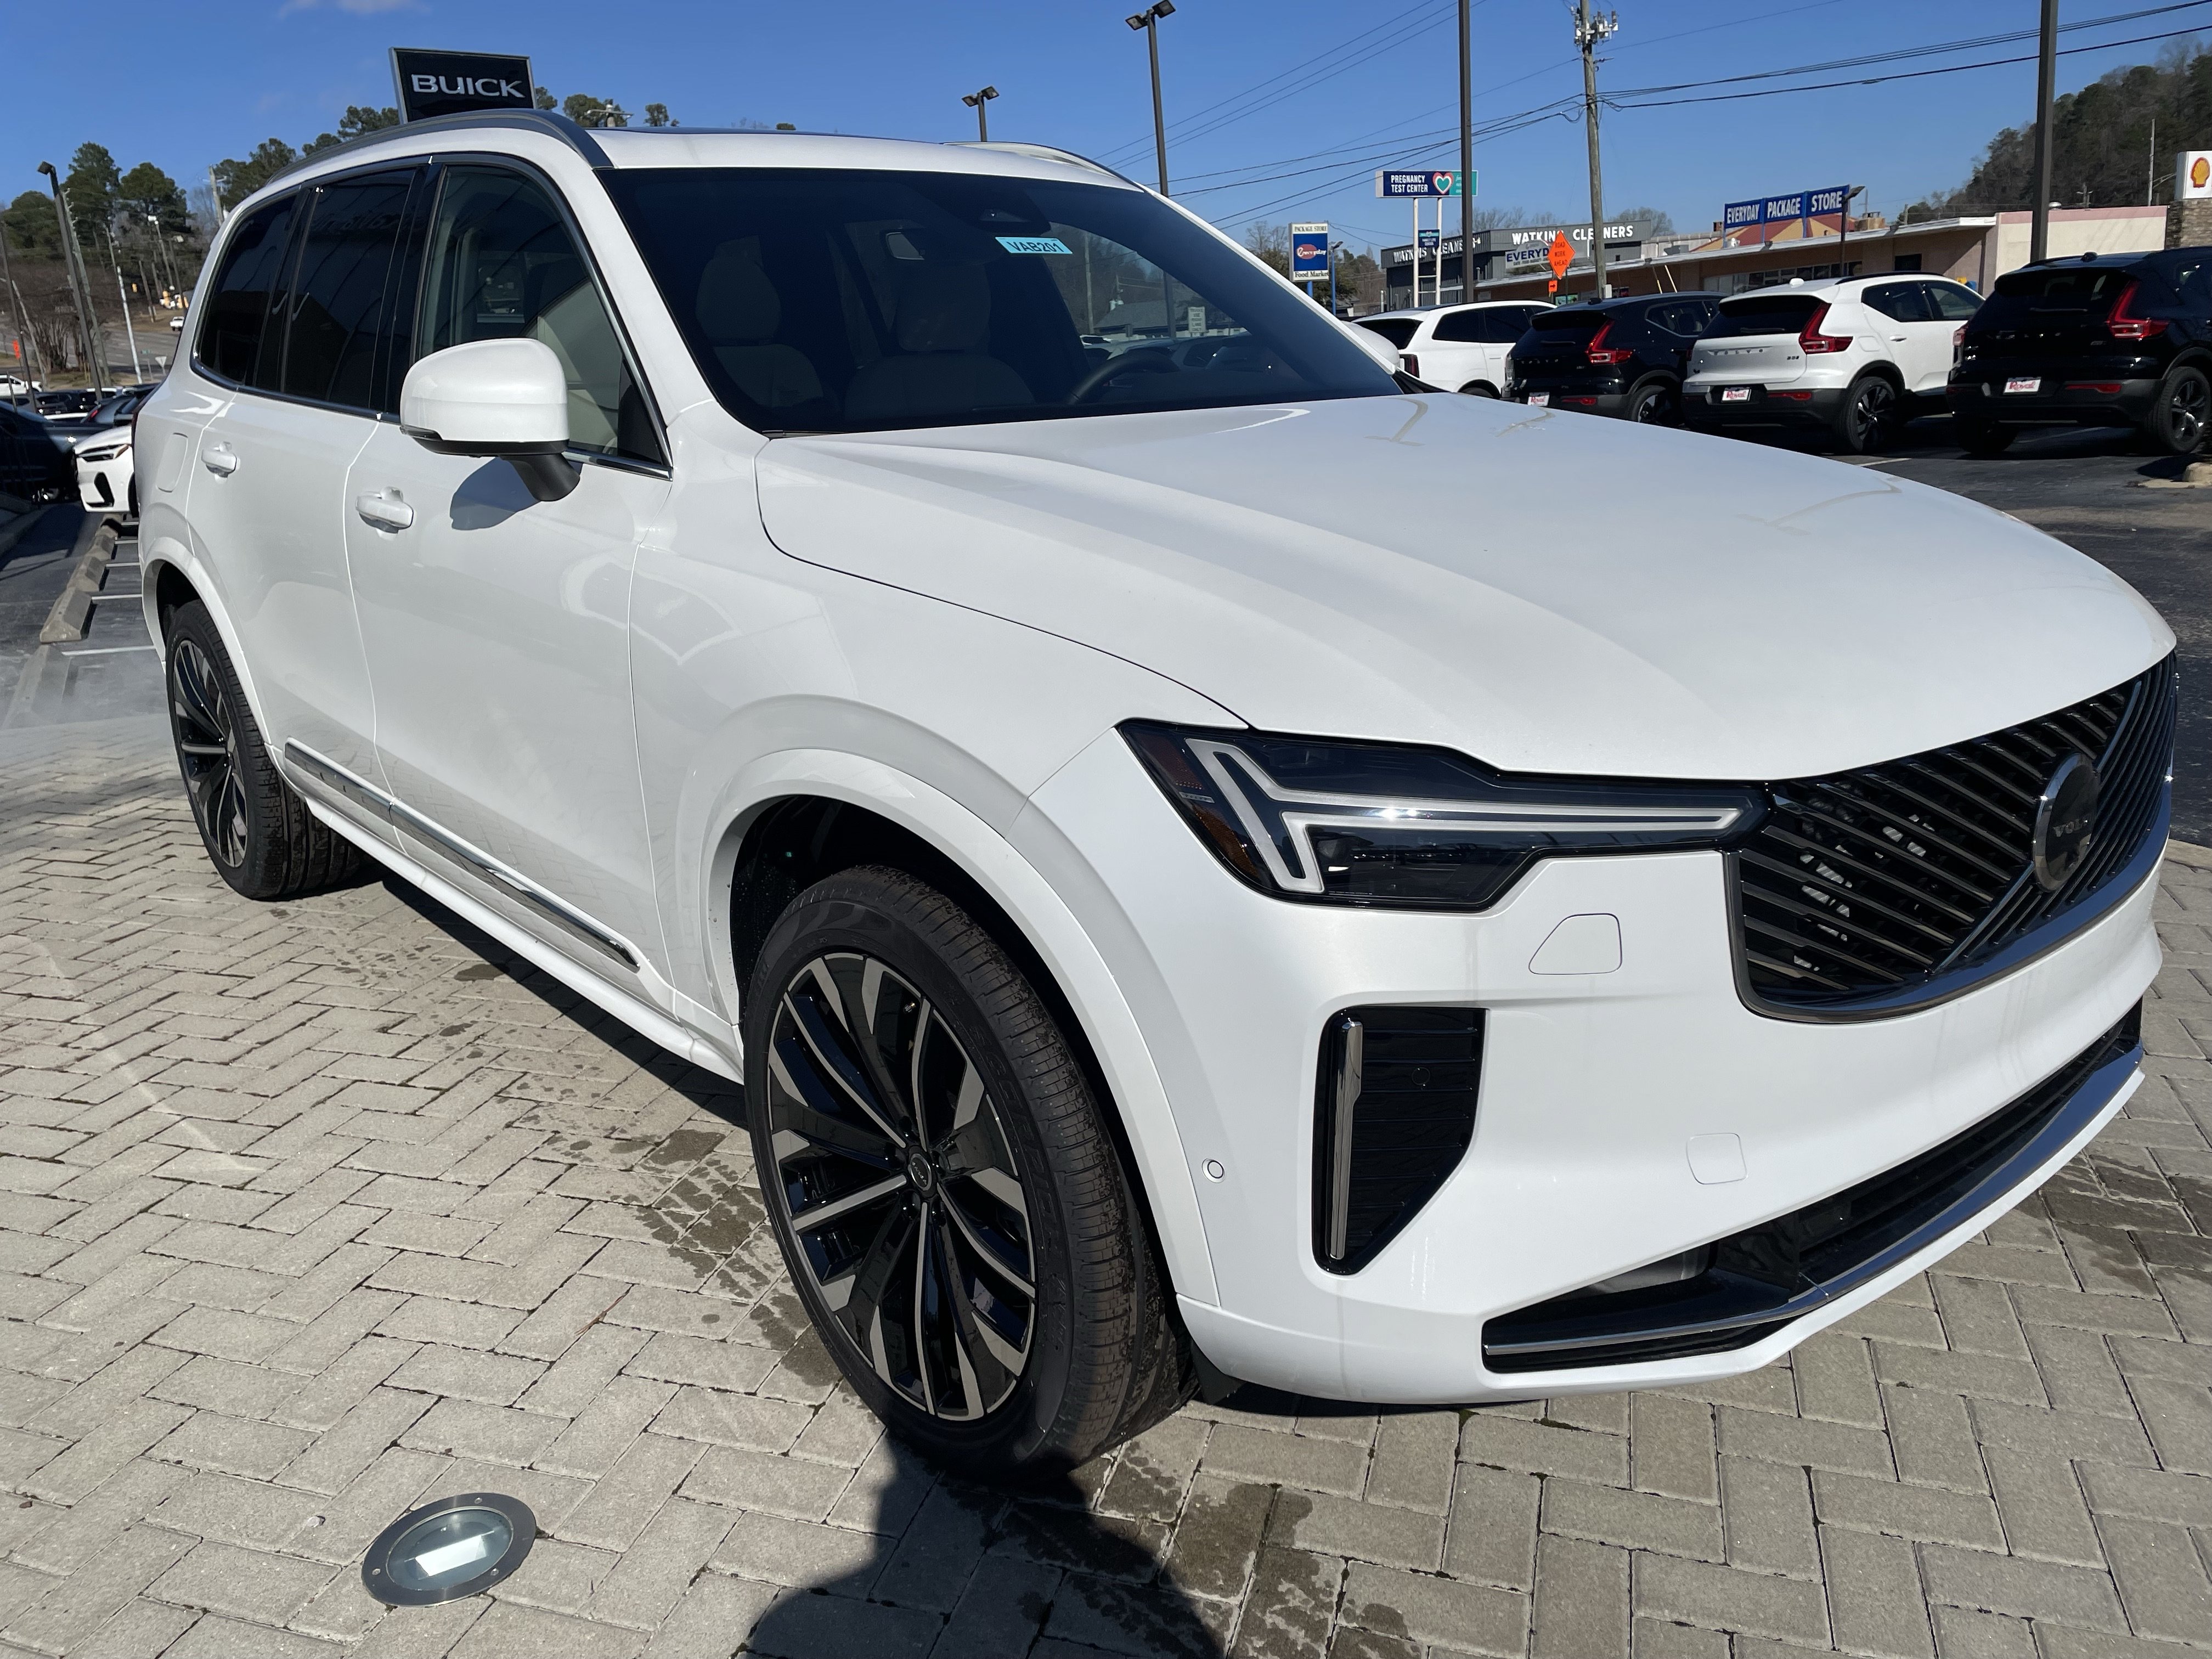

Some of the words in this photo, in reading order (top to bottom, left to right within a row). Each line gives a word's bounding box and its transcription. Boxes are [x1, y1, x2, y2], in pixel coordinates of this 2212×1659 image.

[411, 74, 526, 98] BUICK
[1391, 174, 1426, 183] PREGNANCY
[1391, 184, 1405, 193] TEST
[1407, 184, 1428, 193] CENTER
[1726, 204, 1760, 224] EVERYDAY
[1767, 198, 1801, 218] PACKAGE
[1811, 191, 1843, 212] STORE
[1512, 230, 1564, 245] WATKIN
[1572, 225, 1634, 240] CLENERS
[1006, 241, 1064, 253] VAB201
[1393, 246, 1427, 263] WATKS
[1506, 247, 1549, 262] EVERYD
[2008, 381, 2036, 391] Royal
